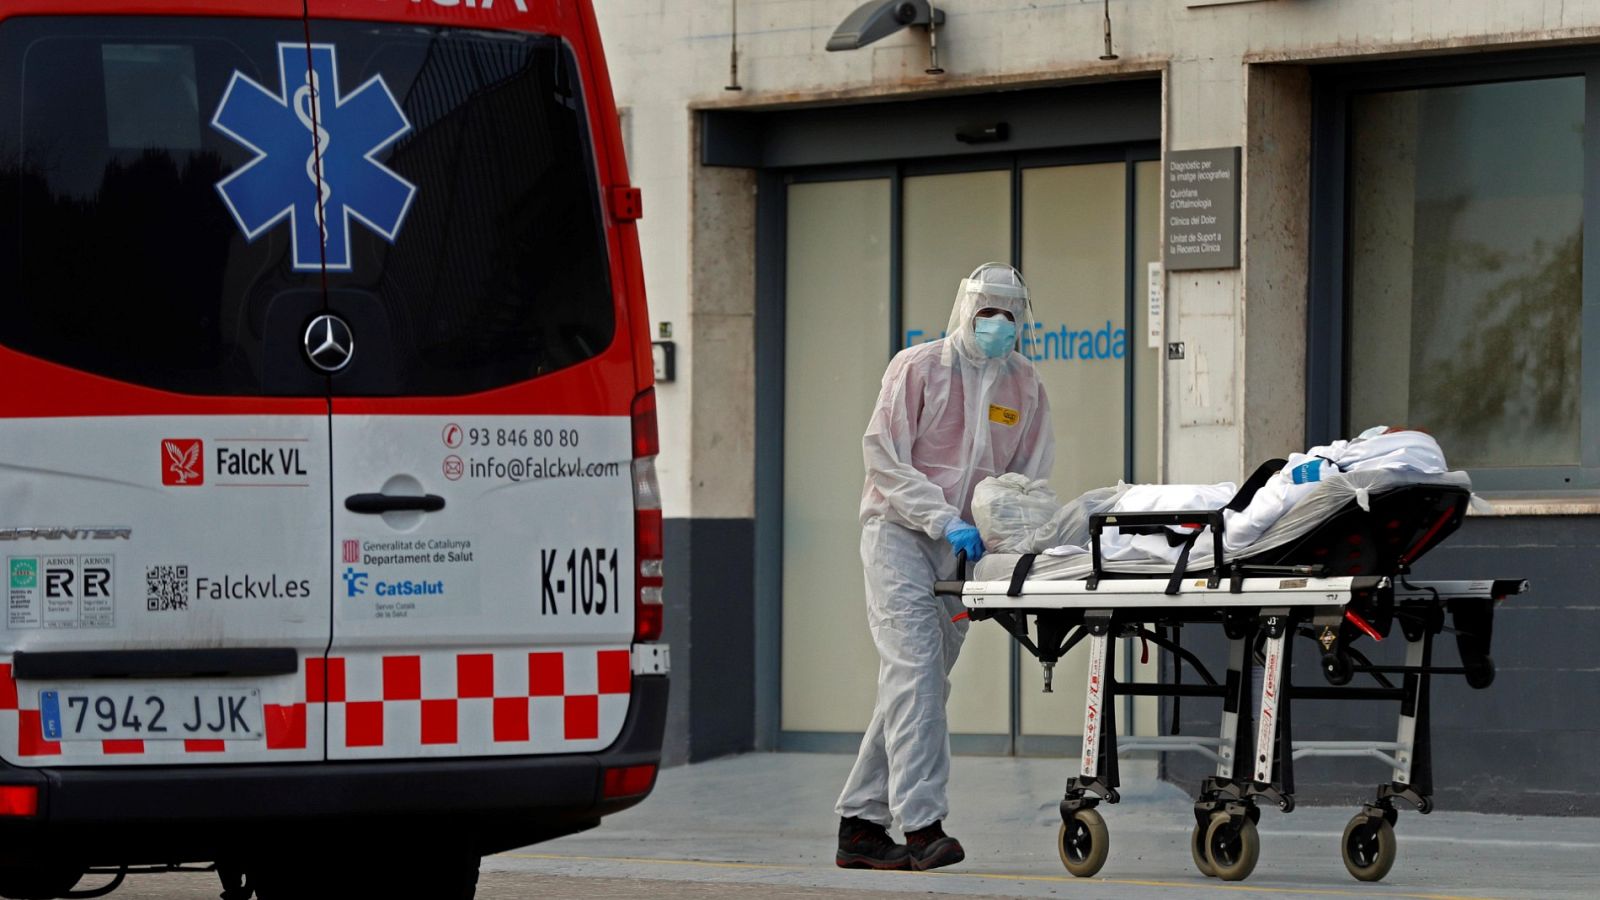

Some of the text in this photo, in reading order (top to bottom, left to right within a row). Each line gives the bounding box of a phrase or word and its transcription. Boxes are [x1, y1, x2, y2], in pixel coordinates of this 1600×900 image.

[1202, 161, 1211, 170] per
[1191, 215, 1199, 225] del
[1201, 215, 1216, 225] Dolor
[1170, 233, 1187, 244] Unitat
[1188, 233, 1196, 242] de
[1197, 232, 1216, 243] Suport
[1170, 245, 1176, 254] la
[1177, 244, 1200, 254] Recerca
[1022, 320, 1127, 361] Entrada
[470, 429, 579, 447] 93 846 80 80
[217, 448, 307, 476] Falck VL
[470, 457, 619, 481] info@falckvl.com
[363, 538, 471, 552] Generalitat de Catalunya
[363, 551, 473, 566] Departament de Salut
[196, 574, 310, 600] Falckvl.es
[375, 580, 444, 596] CatSalut
[541, 547, 619, 615] K-1051
[68, 695, 167, 734] 7942
[183, 695, 250, 733] JJK
